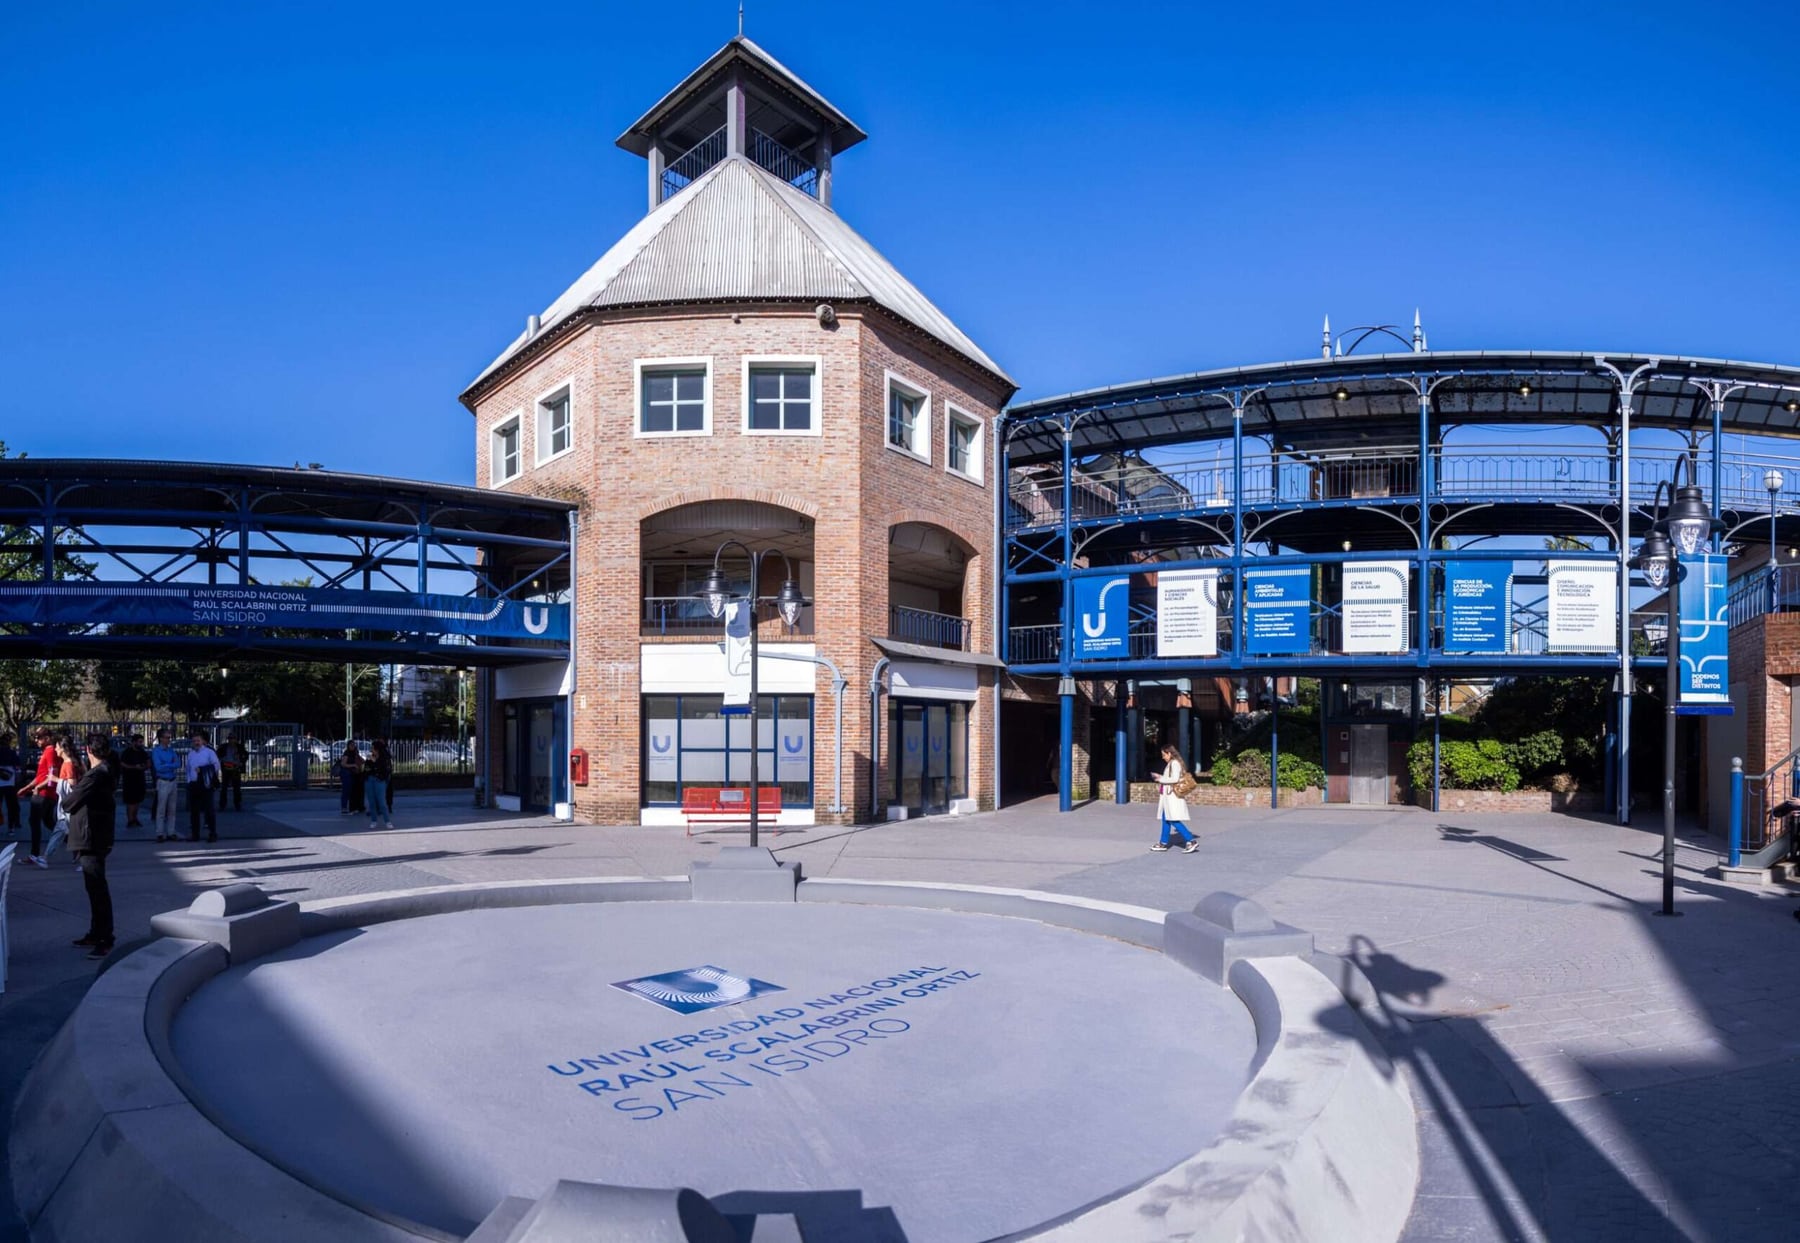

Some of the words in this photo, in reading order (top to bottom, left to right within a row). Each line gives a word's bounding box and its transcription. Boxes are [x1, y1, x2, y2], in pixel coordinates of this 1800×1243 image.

[193, 590, 257, 599] UNIVERSIDAD
[260, 592, 307, 601] NACIONAL
[193, 600, 219, 609] RAÚL
[221, 601, 277, 610] SCALABRINI
[279, 603, 307, 612] ORTIZ
[193, 610, 220, 621] SAN
[224, 611, 266, 623] ISIDRO
[524, 606, 548, 634] U
[547, 1008, 805, 1076] UNIVERSIDAD
[804, 966, 948, 1010] NACIONAL
[578, 1061, 706, 1096] RAÚL
[704, 997, 905, 1062] SCALABRINI
[900, 970, 981, 998] ORTIZ
[614, 1072, 754, 1120] SAN
[750, 1018, 910, 1077] ISIDRO
